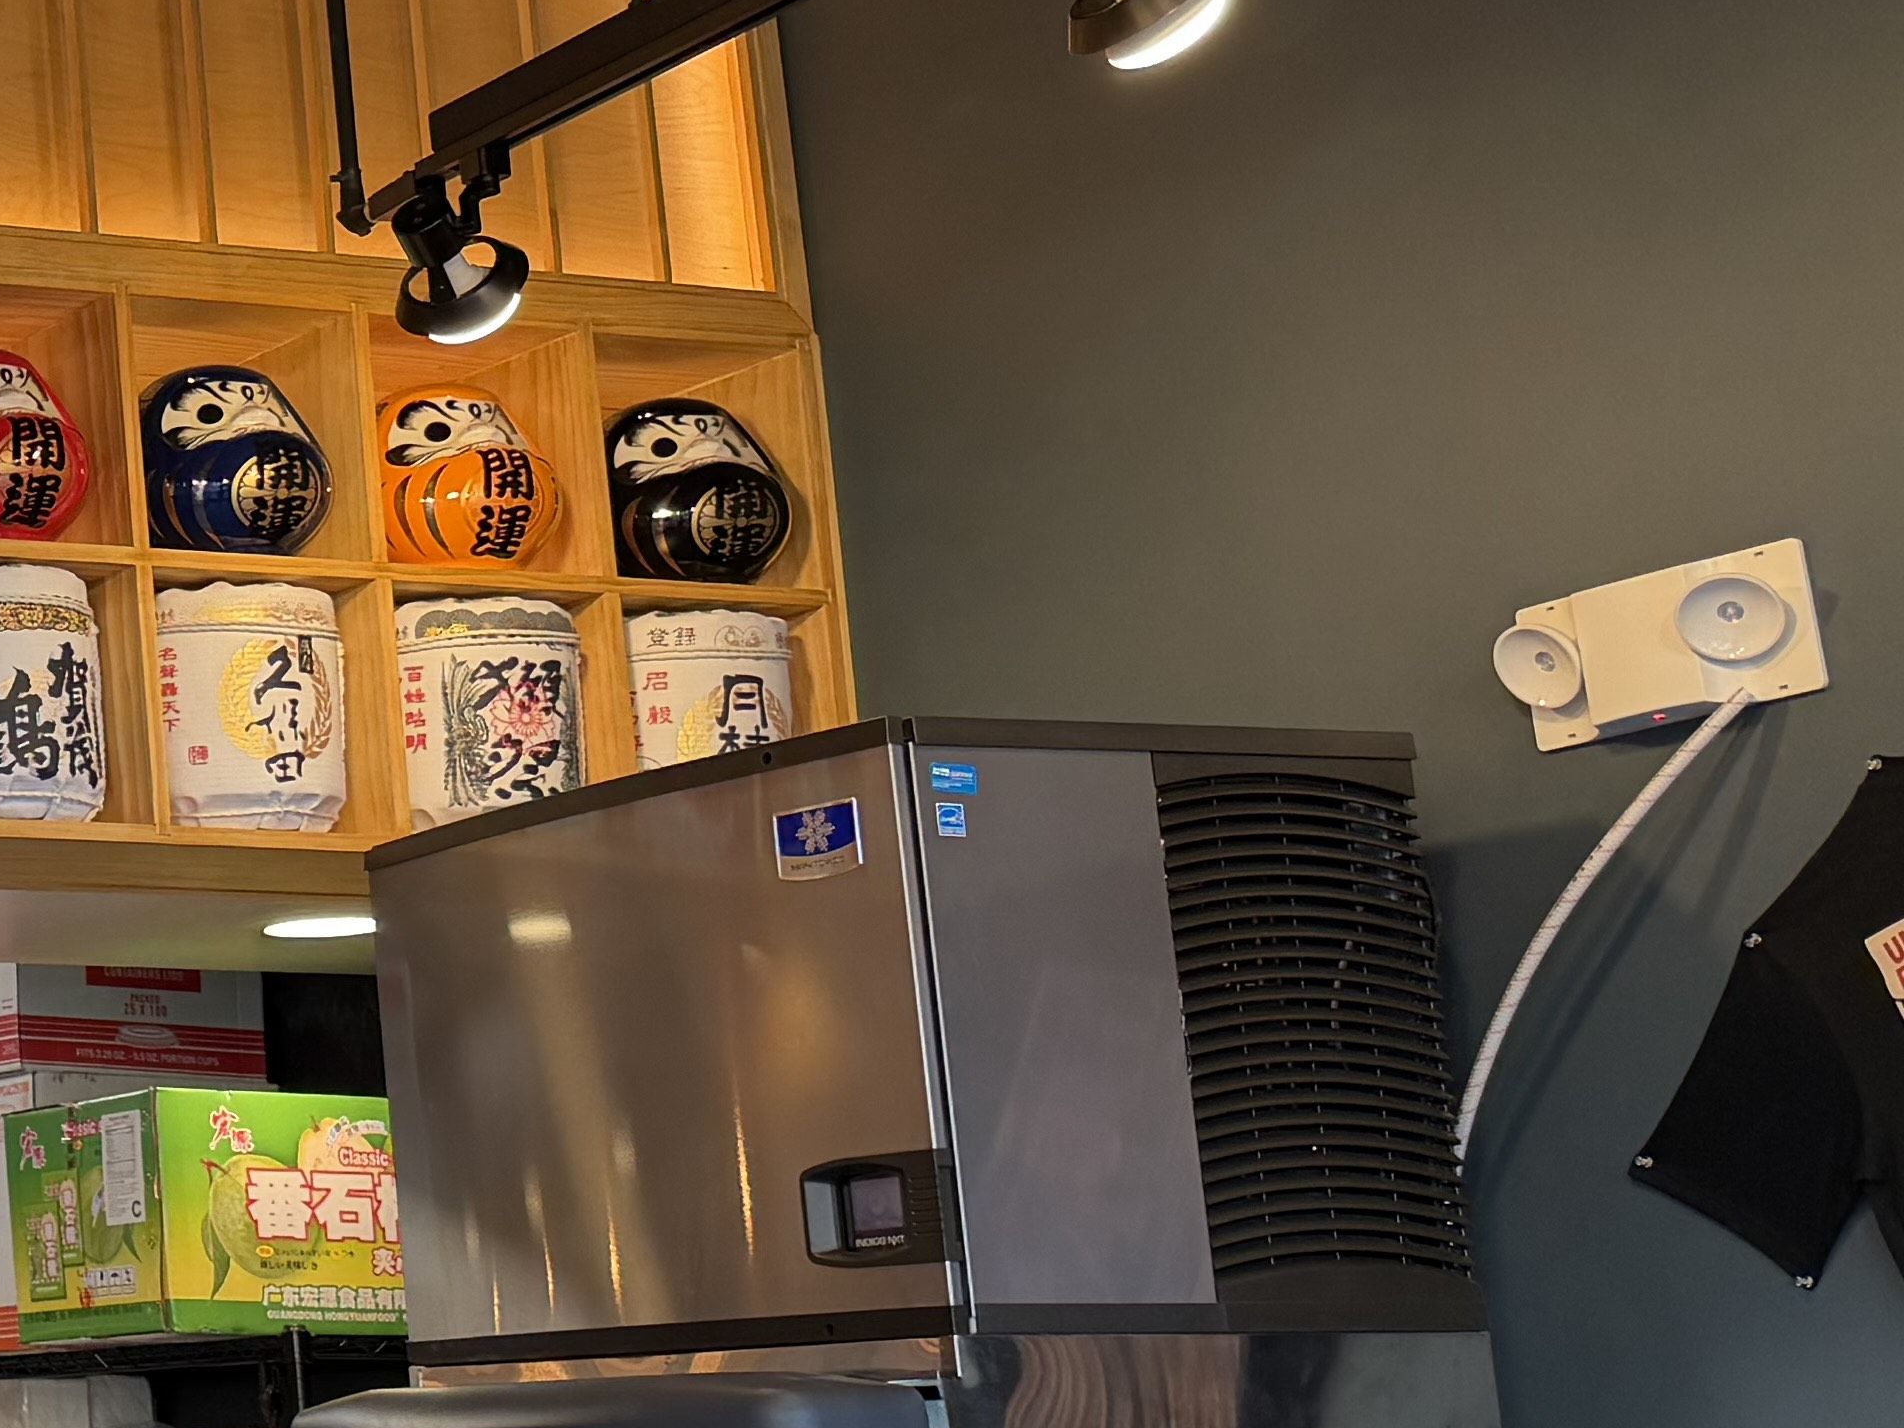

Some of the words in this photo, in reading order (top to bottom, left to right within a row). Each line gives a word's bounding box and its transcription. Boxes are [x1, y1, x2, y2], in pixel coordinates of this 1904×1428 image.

[470, 448, 534, 560] 開運
[245, 646, 306, 783] 久保田
[339, 1148, 389, 1168] Classic
